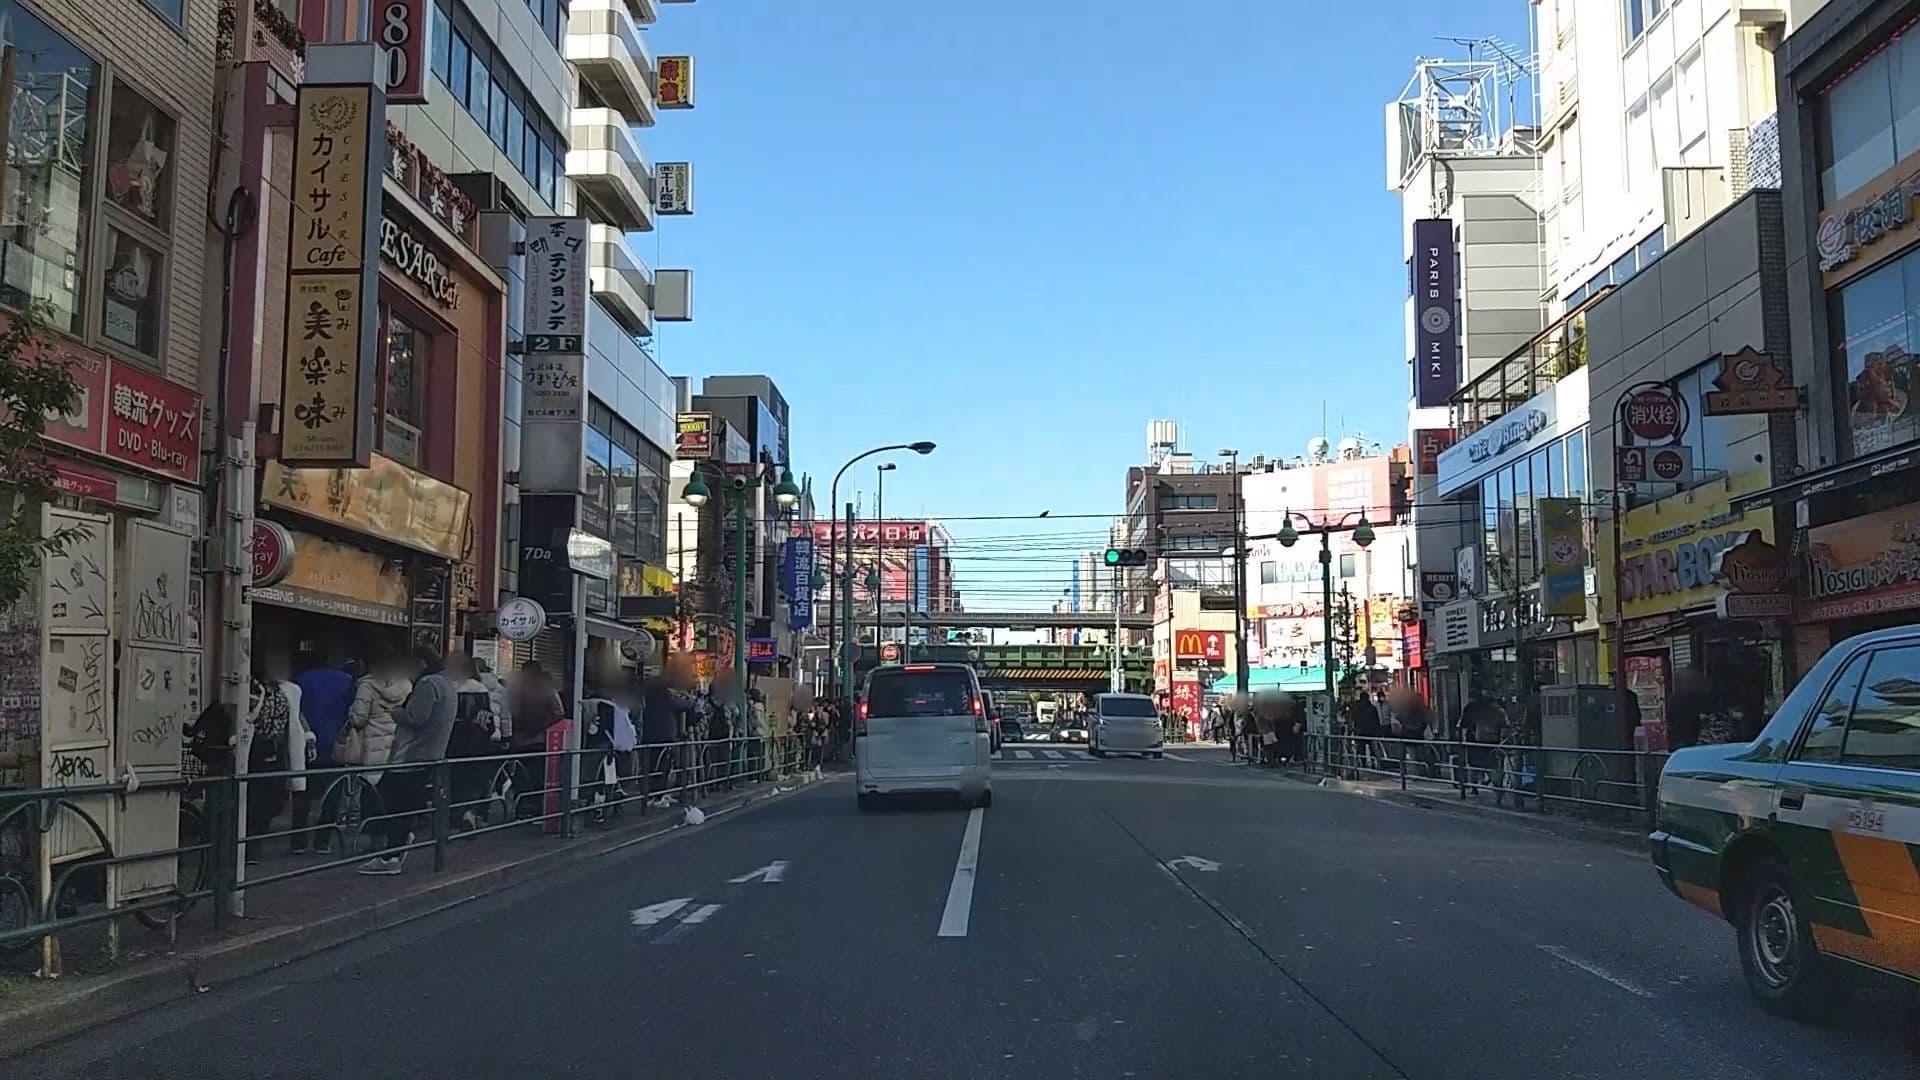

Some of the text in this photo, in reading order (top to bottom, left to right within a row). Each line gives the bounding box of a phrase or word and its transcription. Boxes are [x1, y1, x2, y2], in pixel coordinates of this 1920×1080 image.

[307, 132, 334, 240] カイサル
[338, 136, 352, 241] CAESAR
[307, 247, 347, 267] Cafe
[1430, 248, 1440, 378] PARIS MIKI
[114, 382, 196, 442] 韓流グッズ
[1631, 405, 1674, 425] 消火栓
[794, 540, 810, 617] 韓流百貨店
[500, 616, 538, 627] カイサル
[1482, 600, 1506, 633] the
